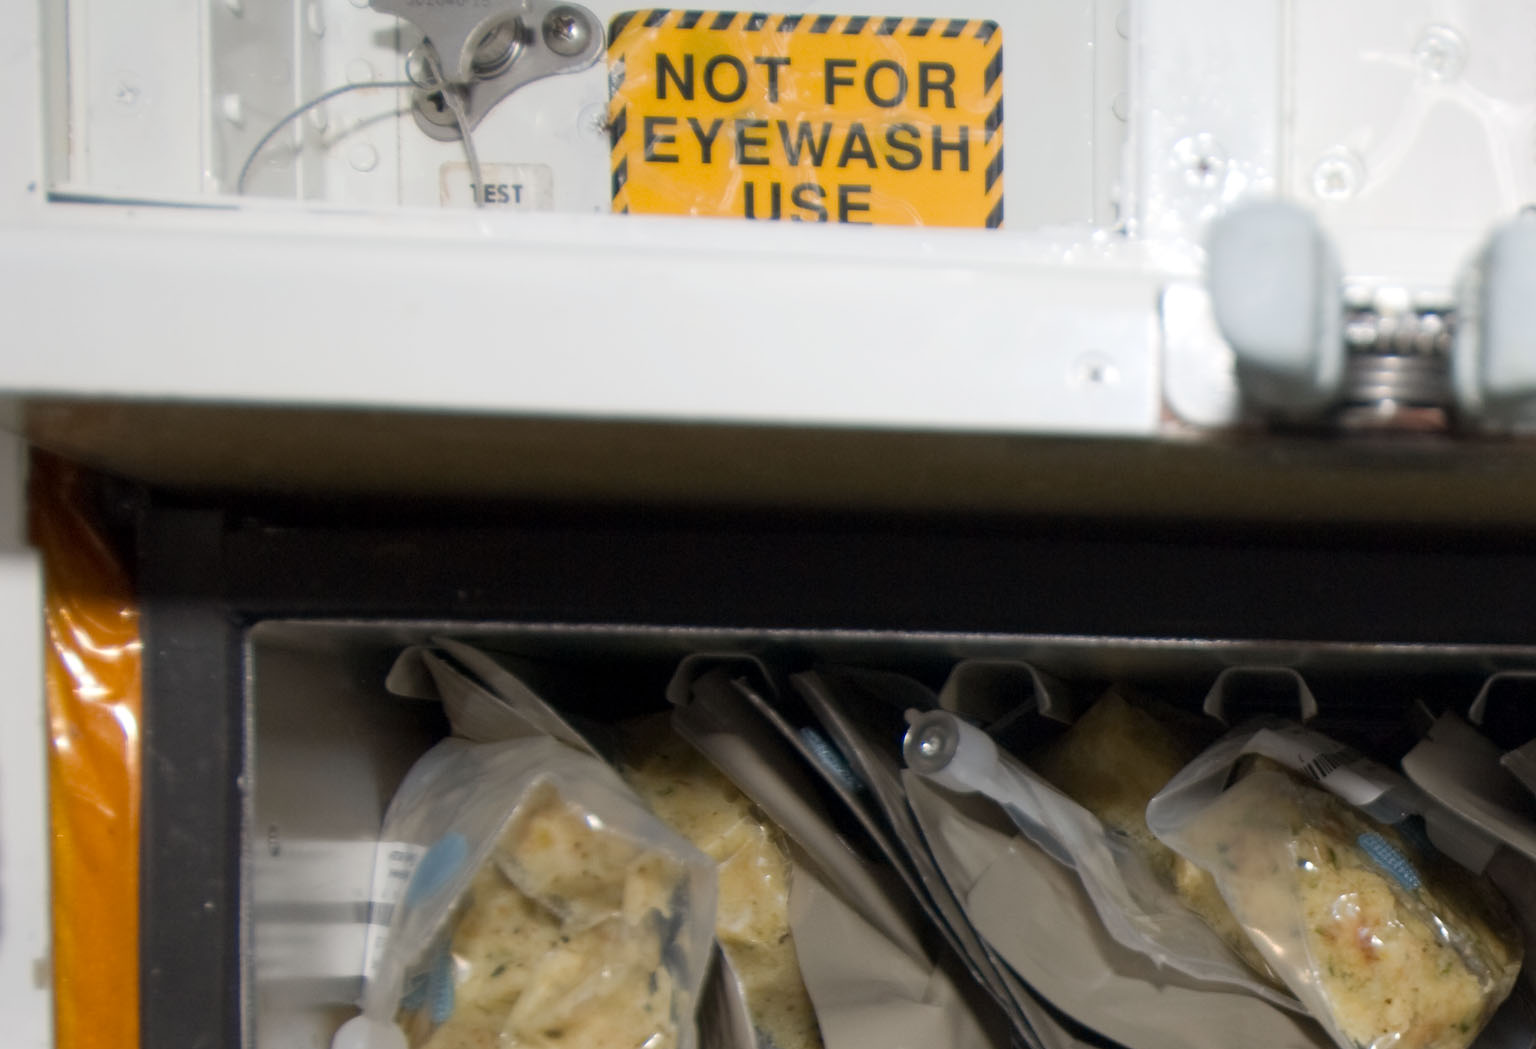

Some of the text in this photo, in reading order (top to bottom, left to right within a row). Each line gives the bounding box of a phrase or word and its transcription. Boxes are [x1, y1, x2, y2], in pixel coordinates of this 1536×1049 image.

[655, 53, 957, 109] NOT FOR
[644, 115, 970, 172] EYEWASH
[469, 183, 524, 205] TEST
[744, 181, 874, 225] USE
